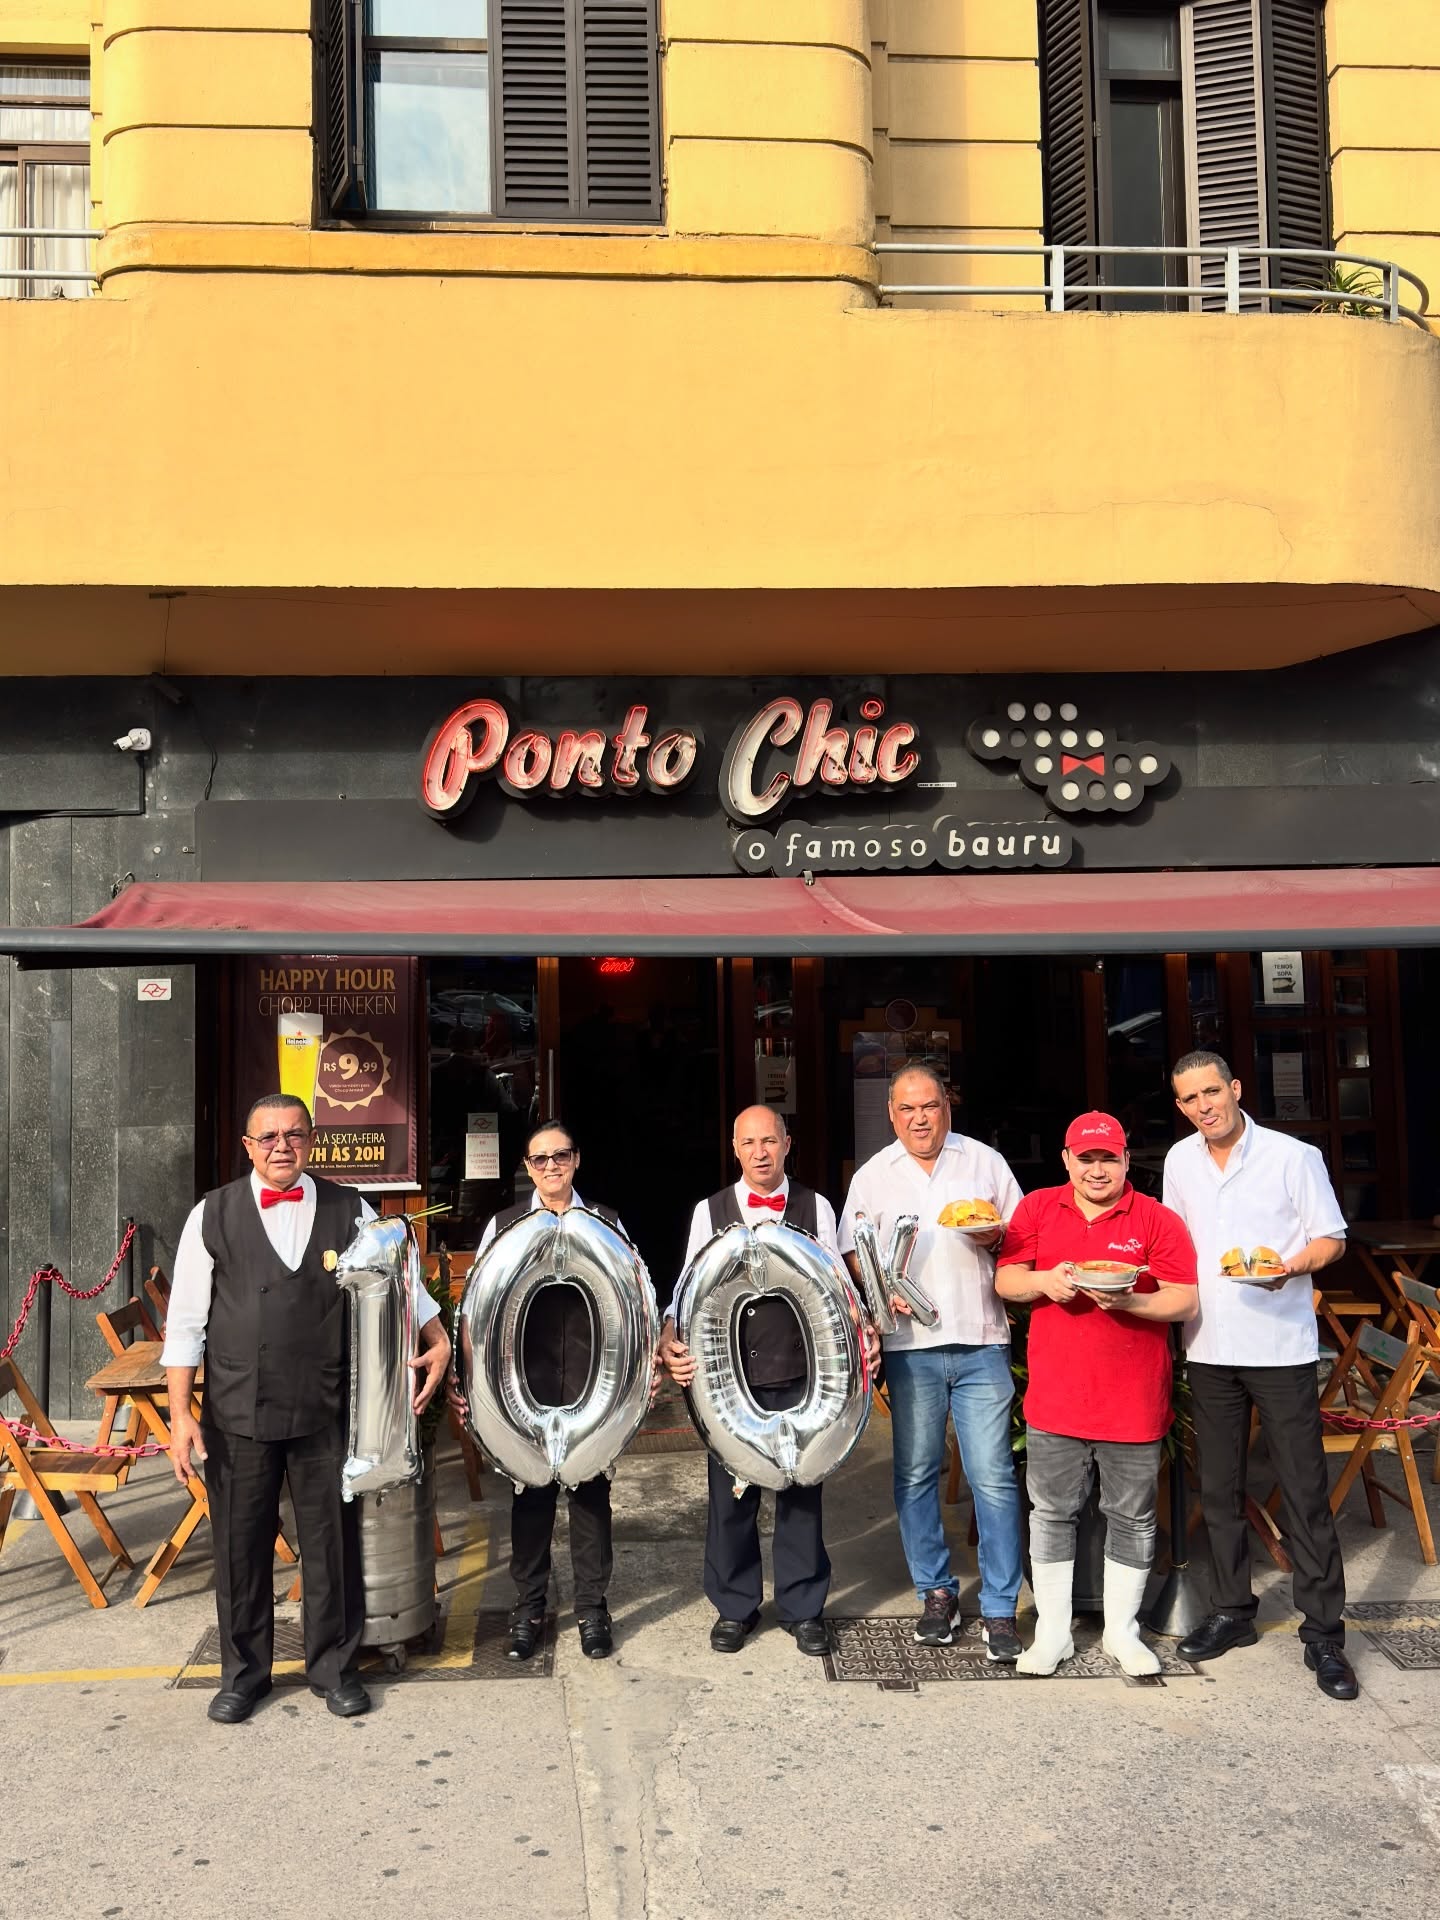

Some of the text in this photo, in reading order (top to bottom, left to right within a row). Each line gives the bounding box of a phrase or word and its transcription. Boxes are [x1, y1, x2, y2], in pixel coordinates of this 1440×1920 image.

[421, 697, 919, 817] Ponto Chic
[748, 830, 1060, 867] o famoso bauru
[260, 968, 395, 991] HAPPY HOUR
[259, 995, 396, 1015] CHOPP HEINEKEN
[323, 1062, 337, 1072] R$
[331, 1133, 386, 1144] SEXTA-FEIRA
[331, 1144, 351, 1161] ÀS
[354, 1145, 385, 1161] 20H
